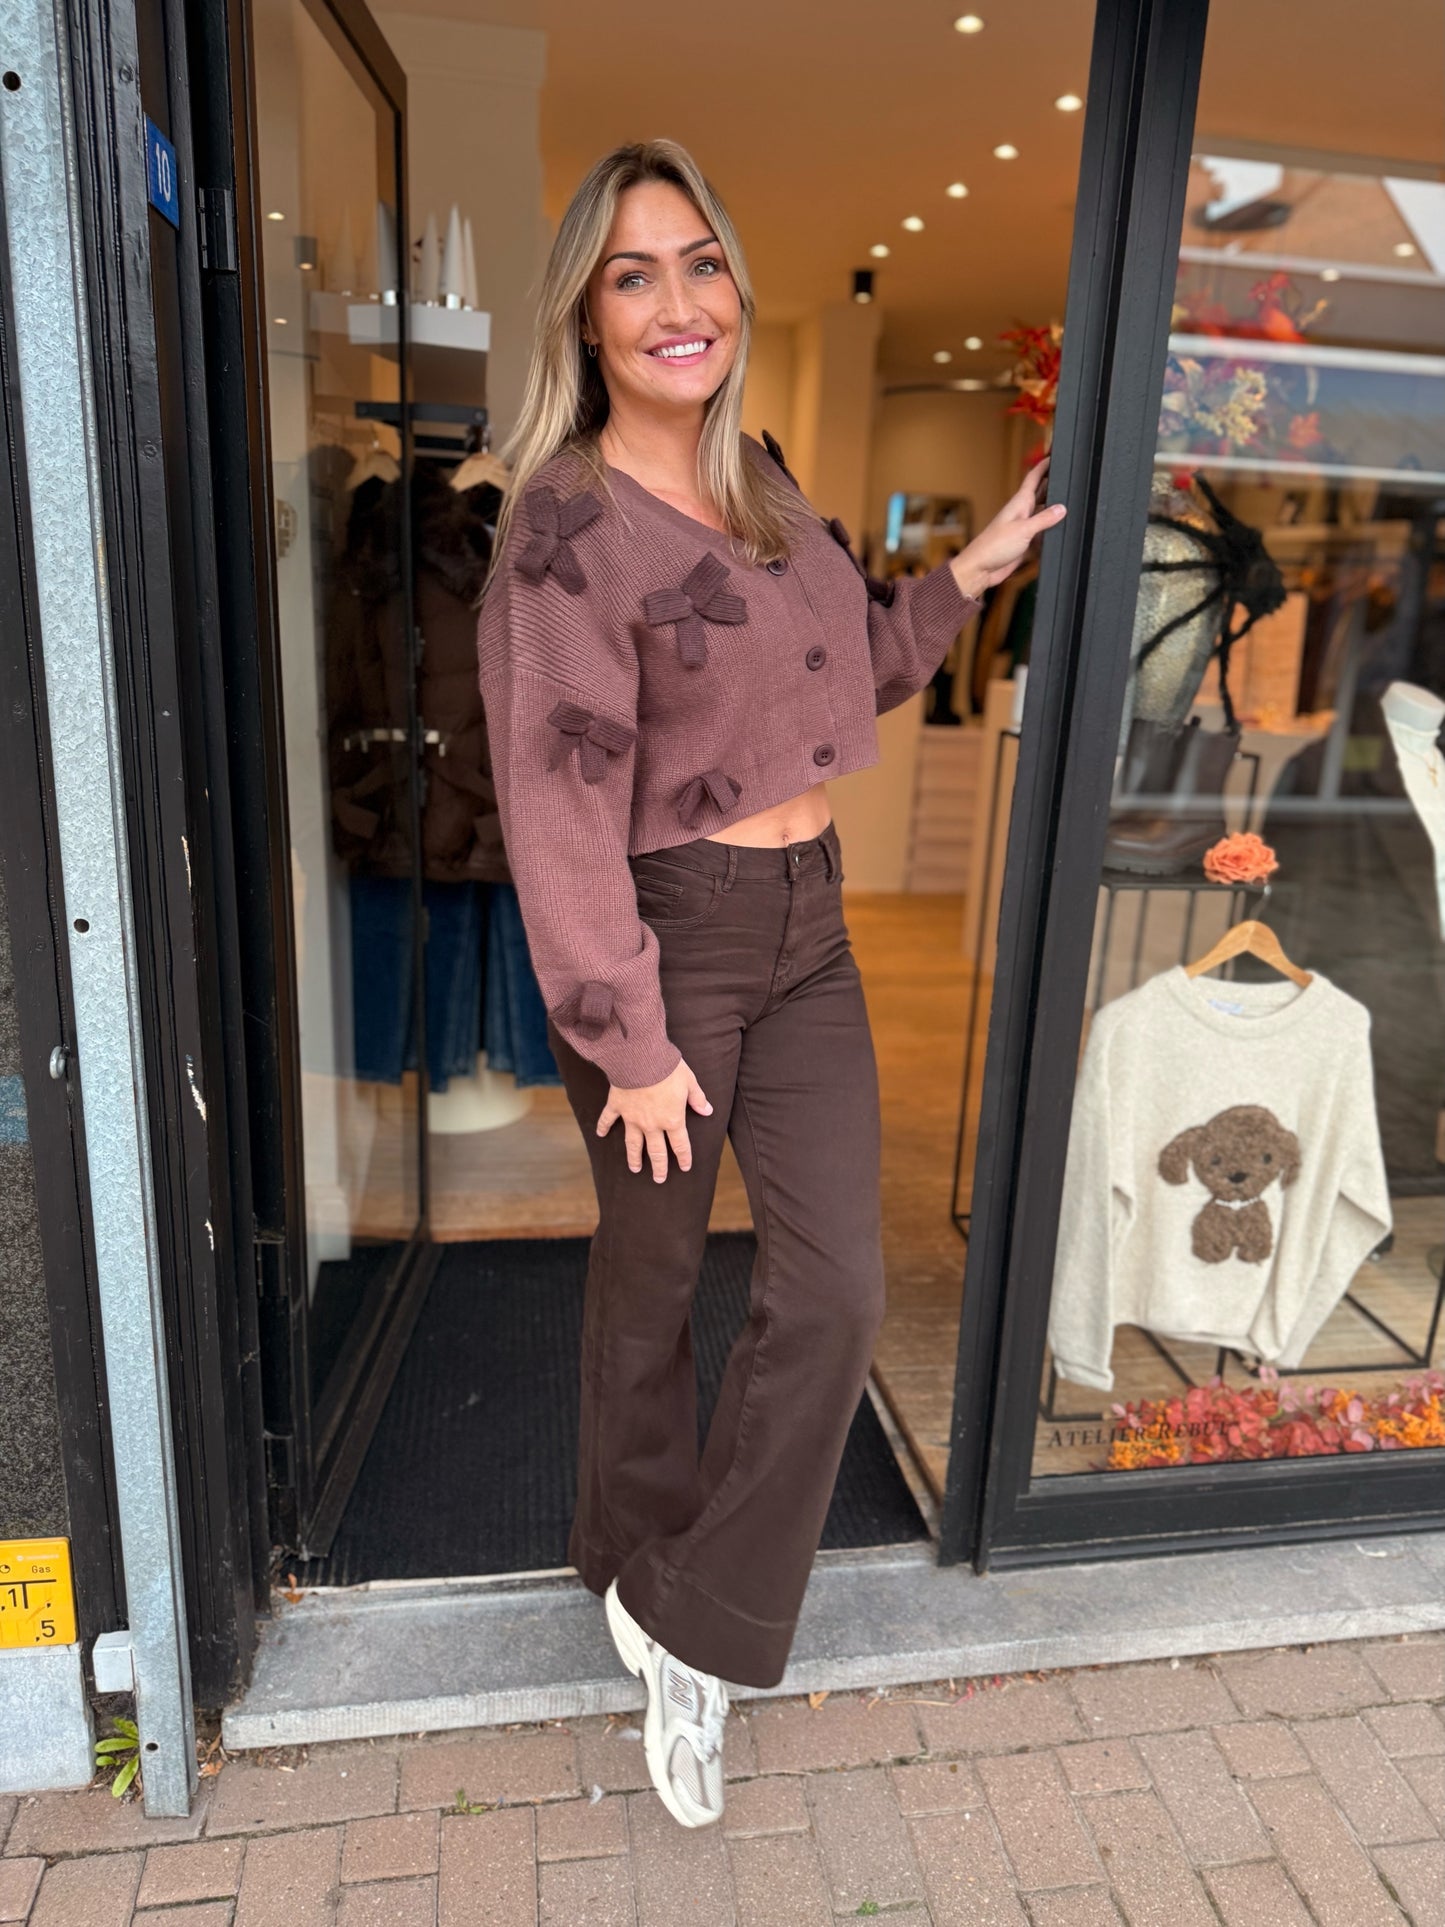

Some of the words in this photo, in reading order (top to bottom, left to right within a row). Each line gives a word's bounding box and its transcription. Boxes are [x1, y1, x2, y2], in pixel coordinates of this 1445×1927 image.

[155, 142, 171, 202] 10
[1049, 1426, 1146, 1448] ATELIER
[31, 1565, 51, 1574] Gas
